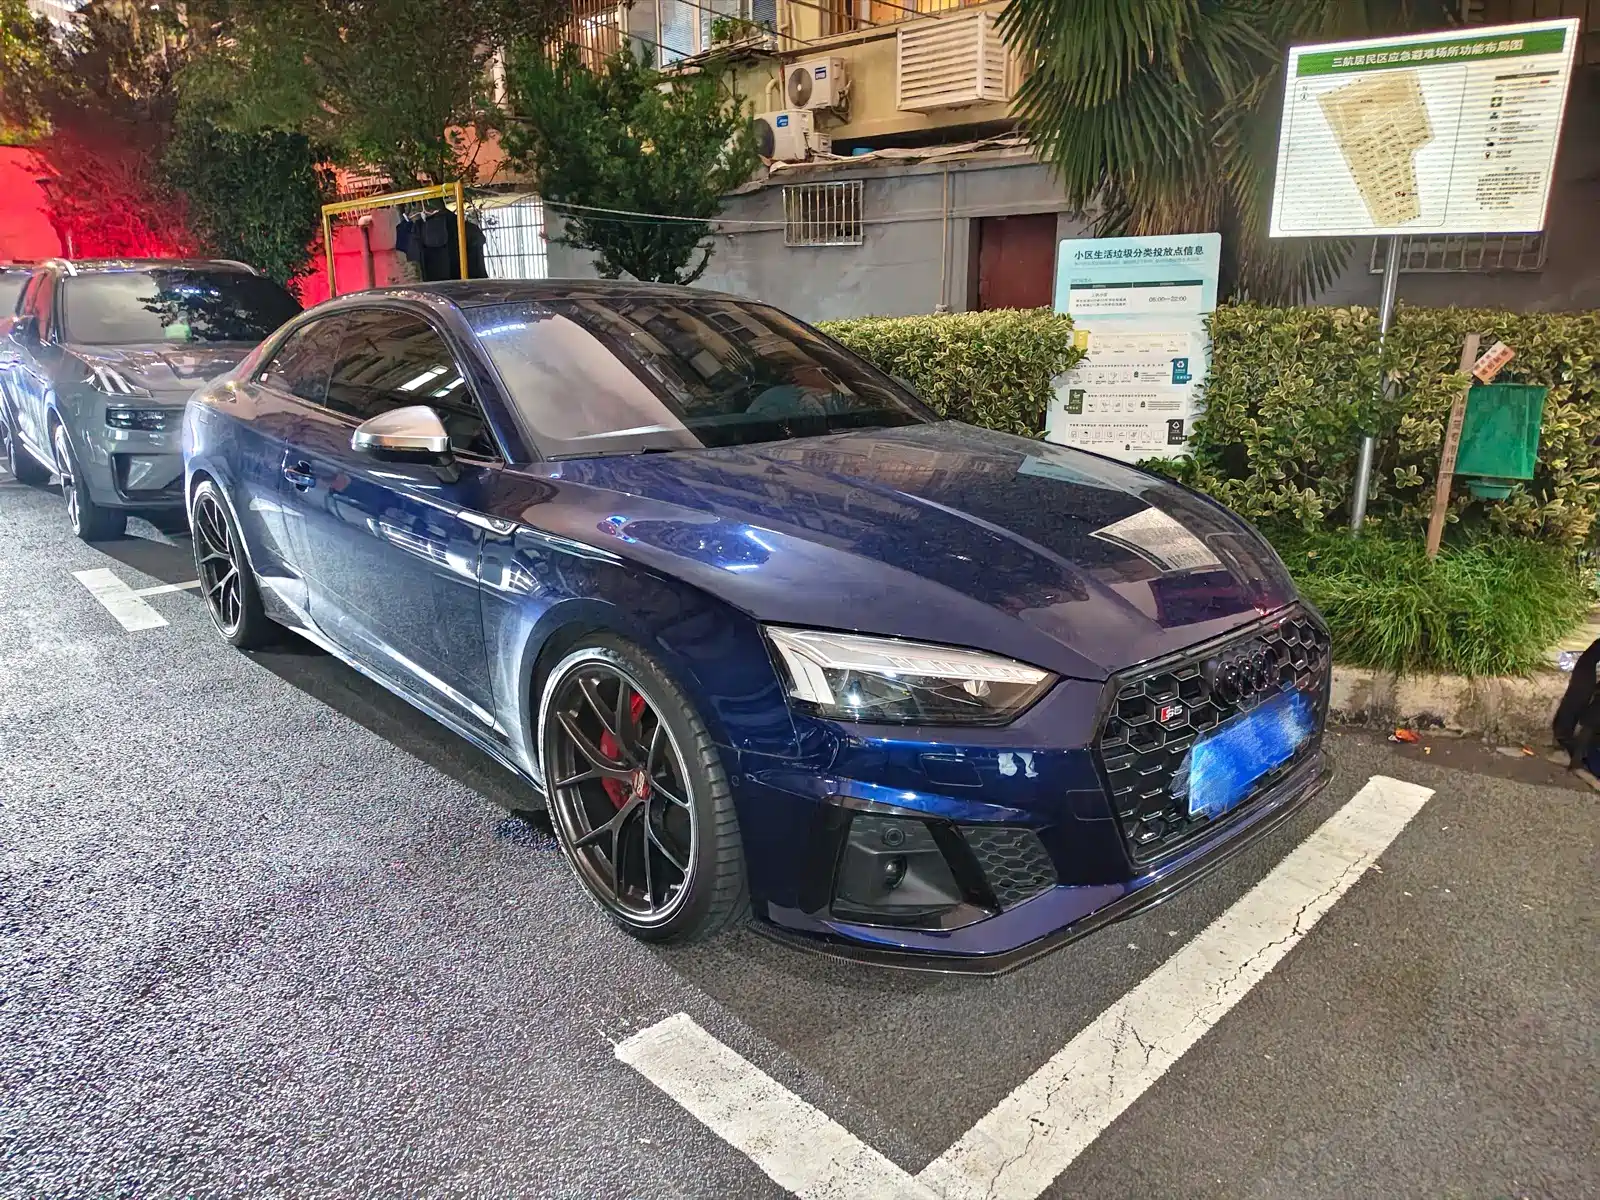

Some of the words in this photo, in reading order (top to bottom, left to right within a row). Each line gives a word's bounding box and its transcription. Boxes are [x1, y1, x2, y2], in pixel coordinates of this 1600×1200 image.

[1332, 39, 1524, 67] 三航居民区应急避难场所功能布局图
[1074, 245, 1204, 260] 小区生活垃圾分类投放点信息
